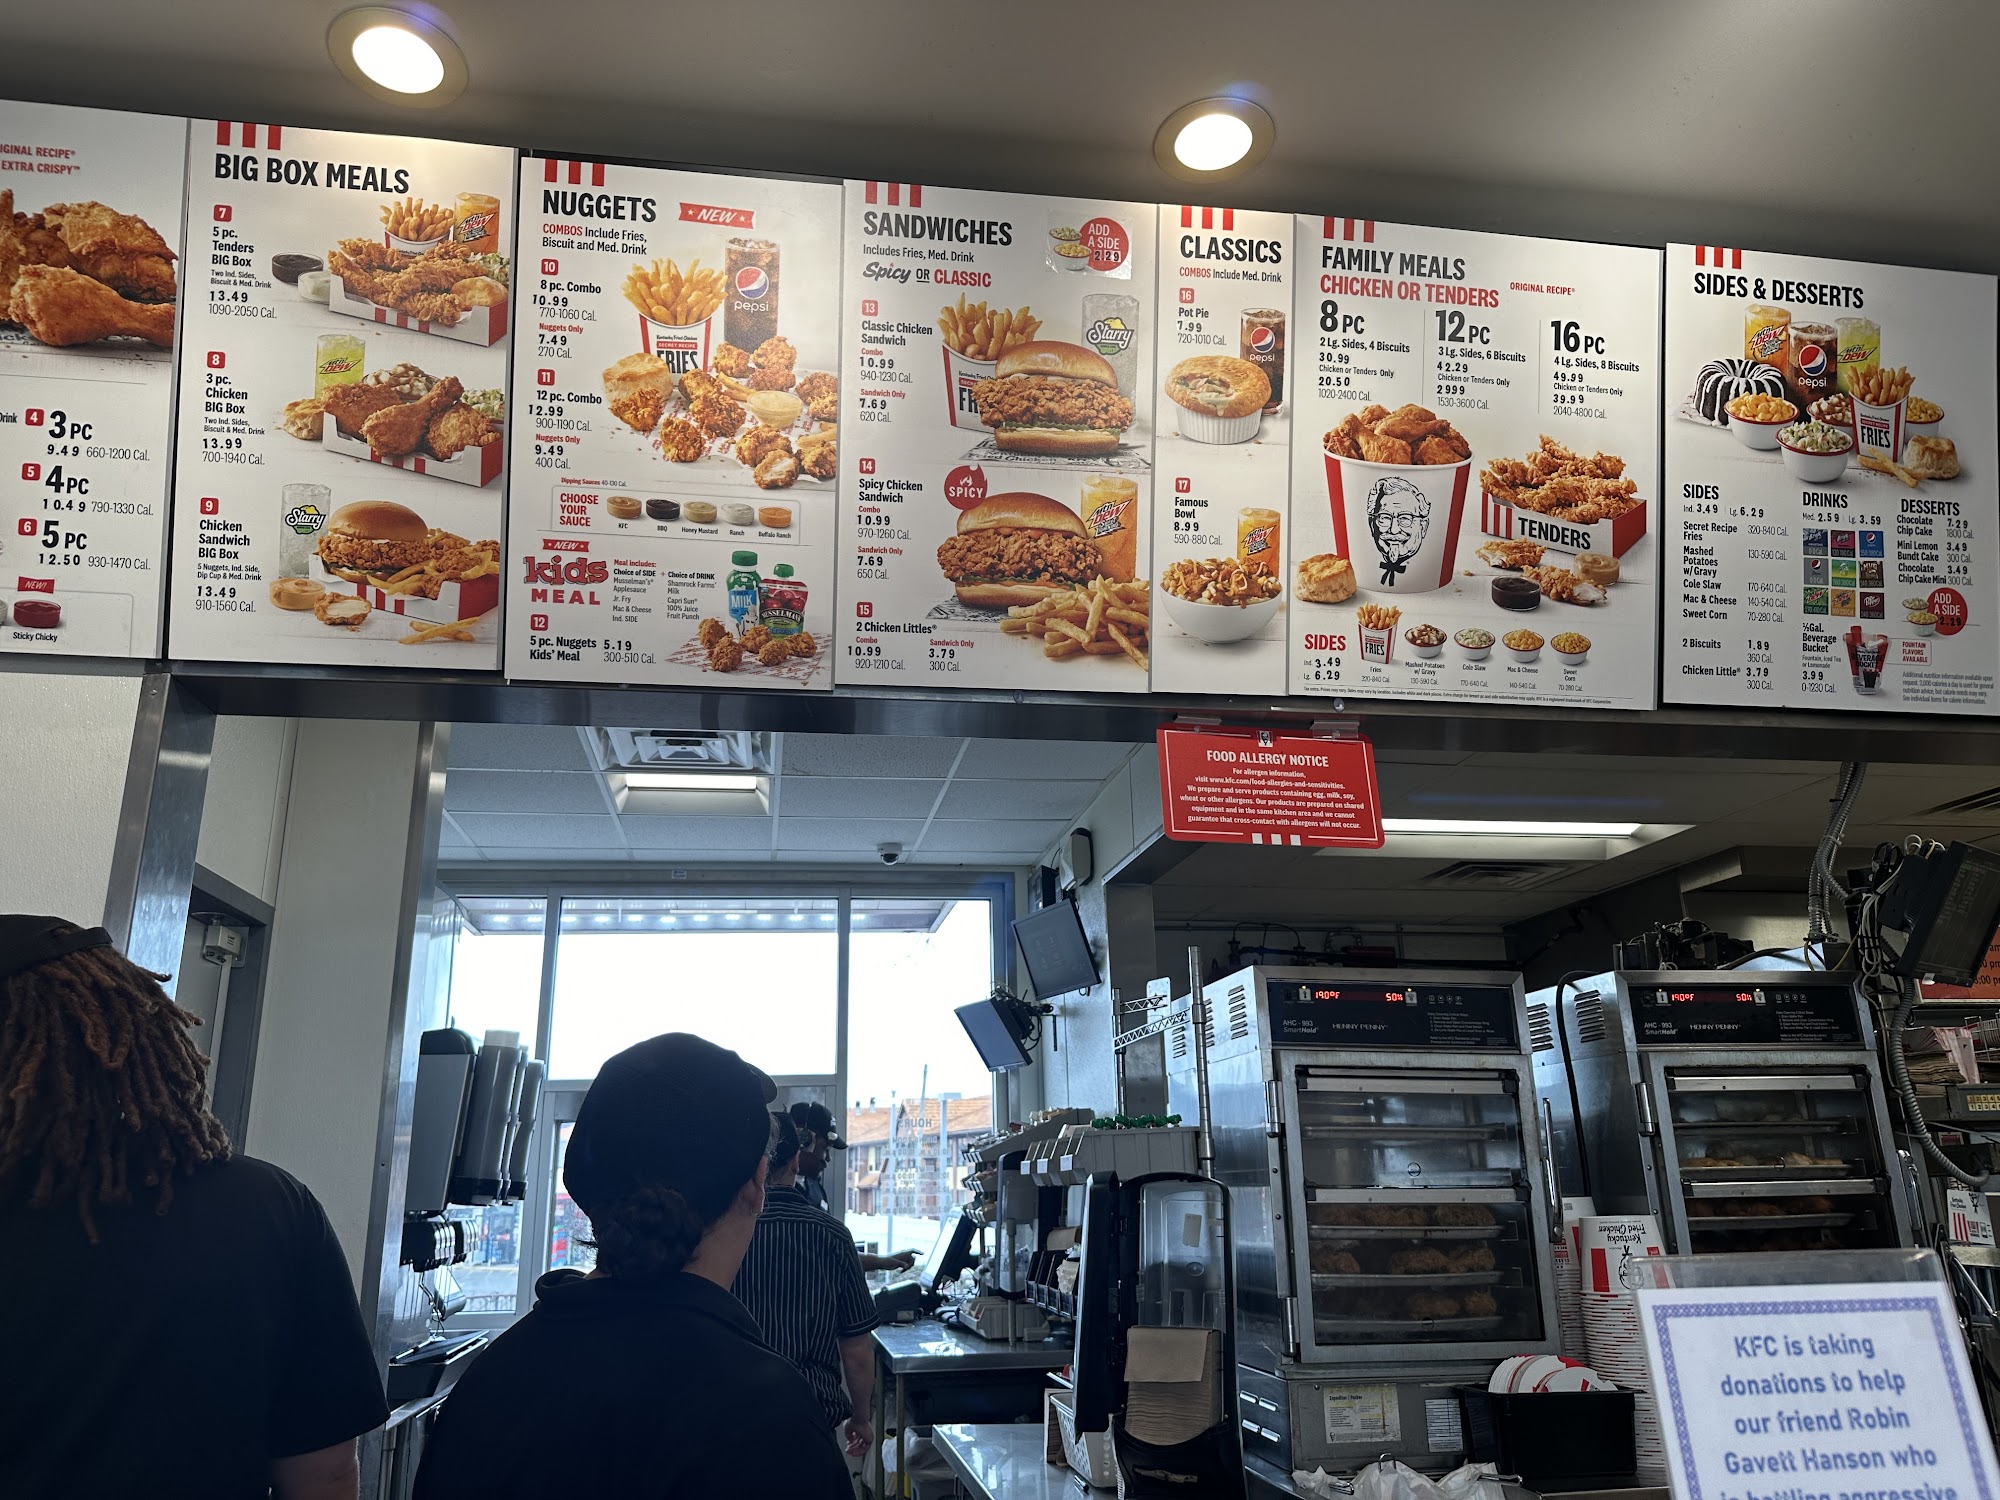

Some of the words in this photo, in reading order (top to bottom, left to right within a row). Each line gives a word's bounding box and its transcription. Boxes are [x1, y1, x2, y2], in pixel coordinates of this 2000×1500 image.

[215, 154, 258, 181] BIG
[267, 158, 318, 186] BOX
[326, 163, 409, 194] MEALS
[543, 190, 656, 222] NUGGETS
[698, 209, 737, 224] NEW
[213, 226, 219, 236] 5
[222, 230, 238, 239] pc.
[543, 224, 582, 236] COMBOS
[586, 227, 619, 239] Include
[622, 230, 646, 243] Fries,
[864, 212, 1012, 246] SANDWICHES
[1088, 224, 1110, 236] ADD
[212, 240, 254, 253] Tenders
[543, 237, 574, 248] Biscuit
[577, 240, 594, 250] and
[598, 242, 618, 252] Med.
[622, 244, 646, 254] Drink
[1088, 236, 1094, 248] A
[1098, 237, 1119, 249] SIDE
[864, 244, 900, 256] Includes
[903, 248, 926, 260] Fries,
[928, 250, 948, 260] Med.
[951, 252, 974, 262] Drink
[1095, 250, 1121, 262] 2.29
[1181, 235, 1281, 264] CLASSICS
[212, 254, 229, 265] BIG
[232, 256, 251, 266] Box
[1322, 246, 1394, 273] FAMILY
[1400, 253, 1465, 280] MEALS
[863, 262, 911, 284] Spicy
[916, 269, 929, 280] OR
[934, 269, 991, 287] CLASSIC
[541, 280, 546, 289] 8
[550, 282, 564, 292] pc.
[567, 282, 601, 293] Combo
[1320, 274, 1392, 298] CHICKEN
[1398, 282, 1420, 301] OR
[1425, 284, 1498, 308] TENDERS
[1694, 273, 1748, 297] SIDES
[1753, 278, 1766, 299] &
[1773, 280, 1863, 308] DESSERTS
[210, 290, 248, 302] 13.49
[533, 295, 568, 307] 10.99
[209, 304, 258, 317] 1090-2050
[261, 307, 276, 318] Cal.
[734, 301, 768, 313] pepsi
[1179, 307, 1193, 317] Pot
[1196, 308, 1209, 318] Pie
[1320, 300, 1338, 332] 8
[1343, 315, 1364, 334] PC
[539, 323, 566, 332] Nuggets
[568, 325, 583, 334] Only
[862, 320, 894, 332] Classic
[897, 323, 932, 335] Chicken
[1178, 321, 1202, 332] 7.99
[1436, 310, 1465, 342] 12
[1469, 326, 1490, 344] PC
[539, 334, 566, 345] 7.49
[862, 334, 906, 346] Sandwich
[1551, 321, 1580, 352] 16
[1585, 336, 1604, 354] PC
[1320, 337, 1325, 346] 2
[1328, 338, 1340, 349] Lg.
[1342, 339, 1367, 350] Sides,
[1369, 341, 1374, 350] 4
[1377, 342, 1410, 352] Biscuits
[860, 357, 894, 368] 10.99
[1320, 352, 1349, 364] 30.99
[1437, 362, 1468, 373] 42.29
[1554, 372, 1583, 382] 49.99
[1798, 377, 1826, 388] pepsi
[49, 411, 66, 438] 3
[70, 423, 92, 440] PC
[1861, 426, 1890, 448] FRIES
[48, 444, 79, 456] 9.49
[87, 447, 130, 459] 660-1200
[134, 450, 150, 460] Cal.
[46, 466, 64, 493] 4
[67, 478, 89, 494] PC
[859, 479, 884, 491] Spicy
[887, 480, 922, 491] Chicken
[560, 493, 598, 504] CHOOSE
[859, 492, 903, 502] Sandwich
[949, 486, 983, 498] SPICY
[1684, 484, 1718, 500] SIDES
[44, 499, 85, 512] 10.49
[1175, 497, 1208, 507] Famous
[1803, 492, 1848, 508] DRINKS
[560, 504, 586, 515] YOUR
[1175, 509, 1195, 518] Bowl
[1902, 499, 1960, 516] DESSERTS
[200, 520, 242, 531] Chicken
[285, 508, 326, 530] Starry
[560, 516, 590, 526] SAUCE
[1897, 514, 1933, 525] Chocolate
[1174, 522, 1198, 531] 8.99
[1518, 517, 1592, 549] TENDERS
[1684, 521, 1708, 531] Secret
[1712, 523, 1737, 534] Recipe
[199, 534, 250, 546] Sandwich
[1684, 531, 1702, 540] Fries
[1684, 546, 1713, 556] Mashed
[1684, 556, 1718, 566] Potatoes
[523, 555, 608, 585] kids
[532, 588, 600, 605] MEAL
[13, 632, 34, 641] Sticky
[36, 633, 57, 642] Chicky
[530, 636, 536, 645] 5
[539, 638, 553, 648] pc.
[556, 637, 596, 649] Nuggets
[1305, 634, 1346, 651] SIDES
[1803, 633, 1836, 644] Beverage
[604, 640, 631, 650] 5.19
[1803, 643, 1828, 652] Bucket
[557, 650, 580, 661] Meal
[1316, 657, 1340, 668] 3.49
[1207, 750, 1236, 762] FOOD
[1240, 752, 1286, 764] ALLERGY
[1290, 755, 1328, 766] NOTICE
[1192, 805, 1224, 813] equipment
[1274, 808, 1296, 816] kitchen
[1734, 1336, 1778, 1358] KFC
[1784, 1335, 1803, 1356] is
[1808, 1333, 1875, 1359] taking
[1721, 1372, 1826, 1396] donations
[1831, 1372, 1853, 1392] to
[1858, 1369, 1905, 1396] help
[1735, 1418, 1770, 1434] our
[1777, 1408, 1842, 1432] friend
[1848, 1406, 1910, 1430] Robin
[1724, 1451, 1797, 1474] Gavett
[1802, 1448, 1886, 1471] Hanson
[1890, 1444, 1937, 1467] who
